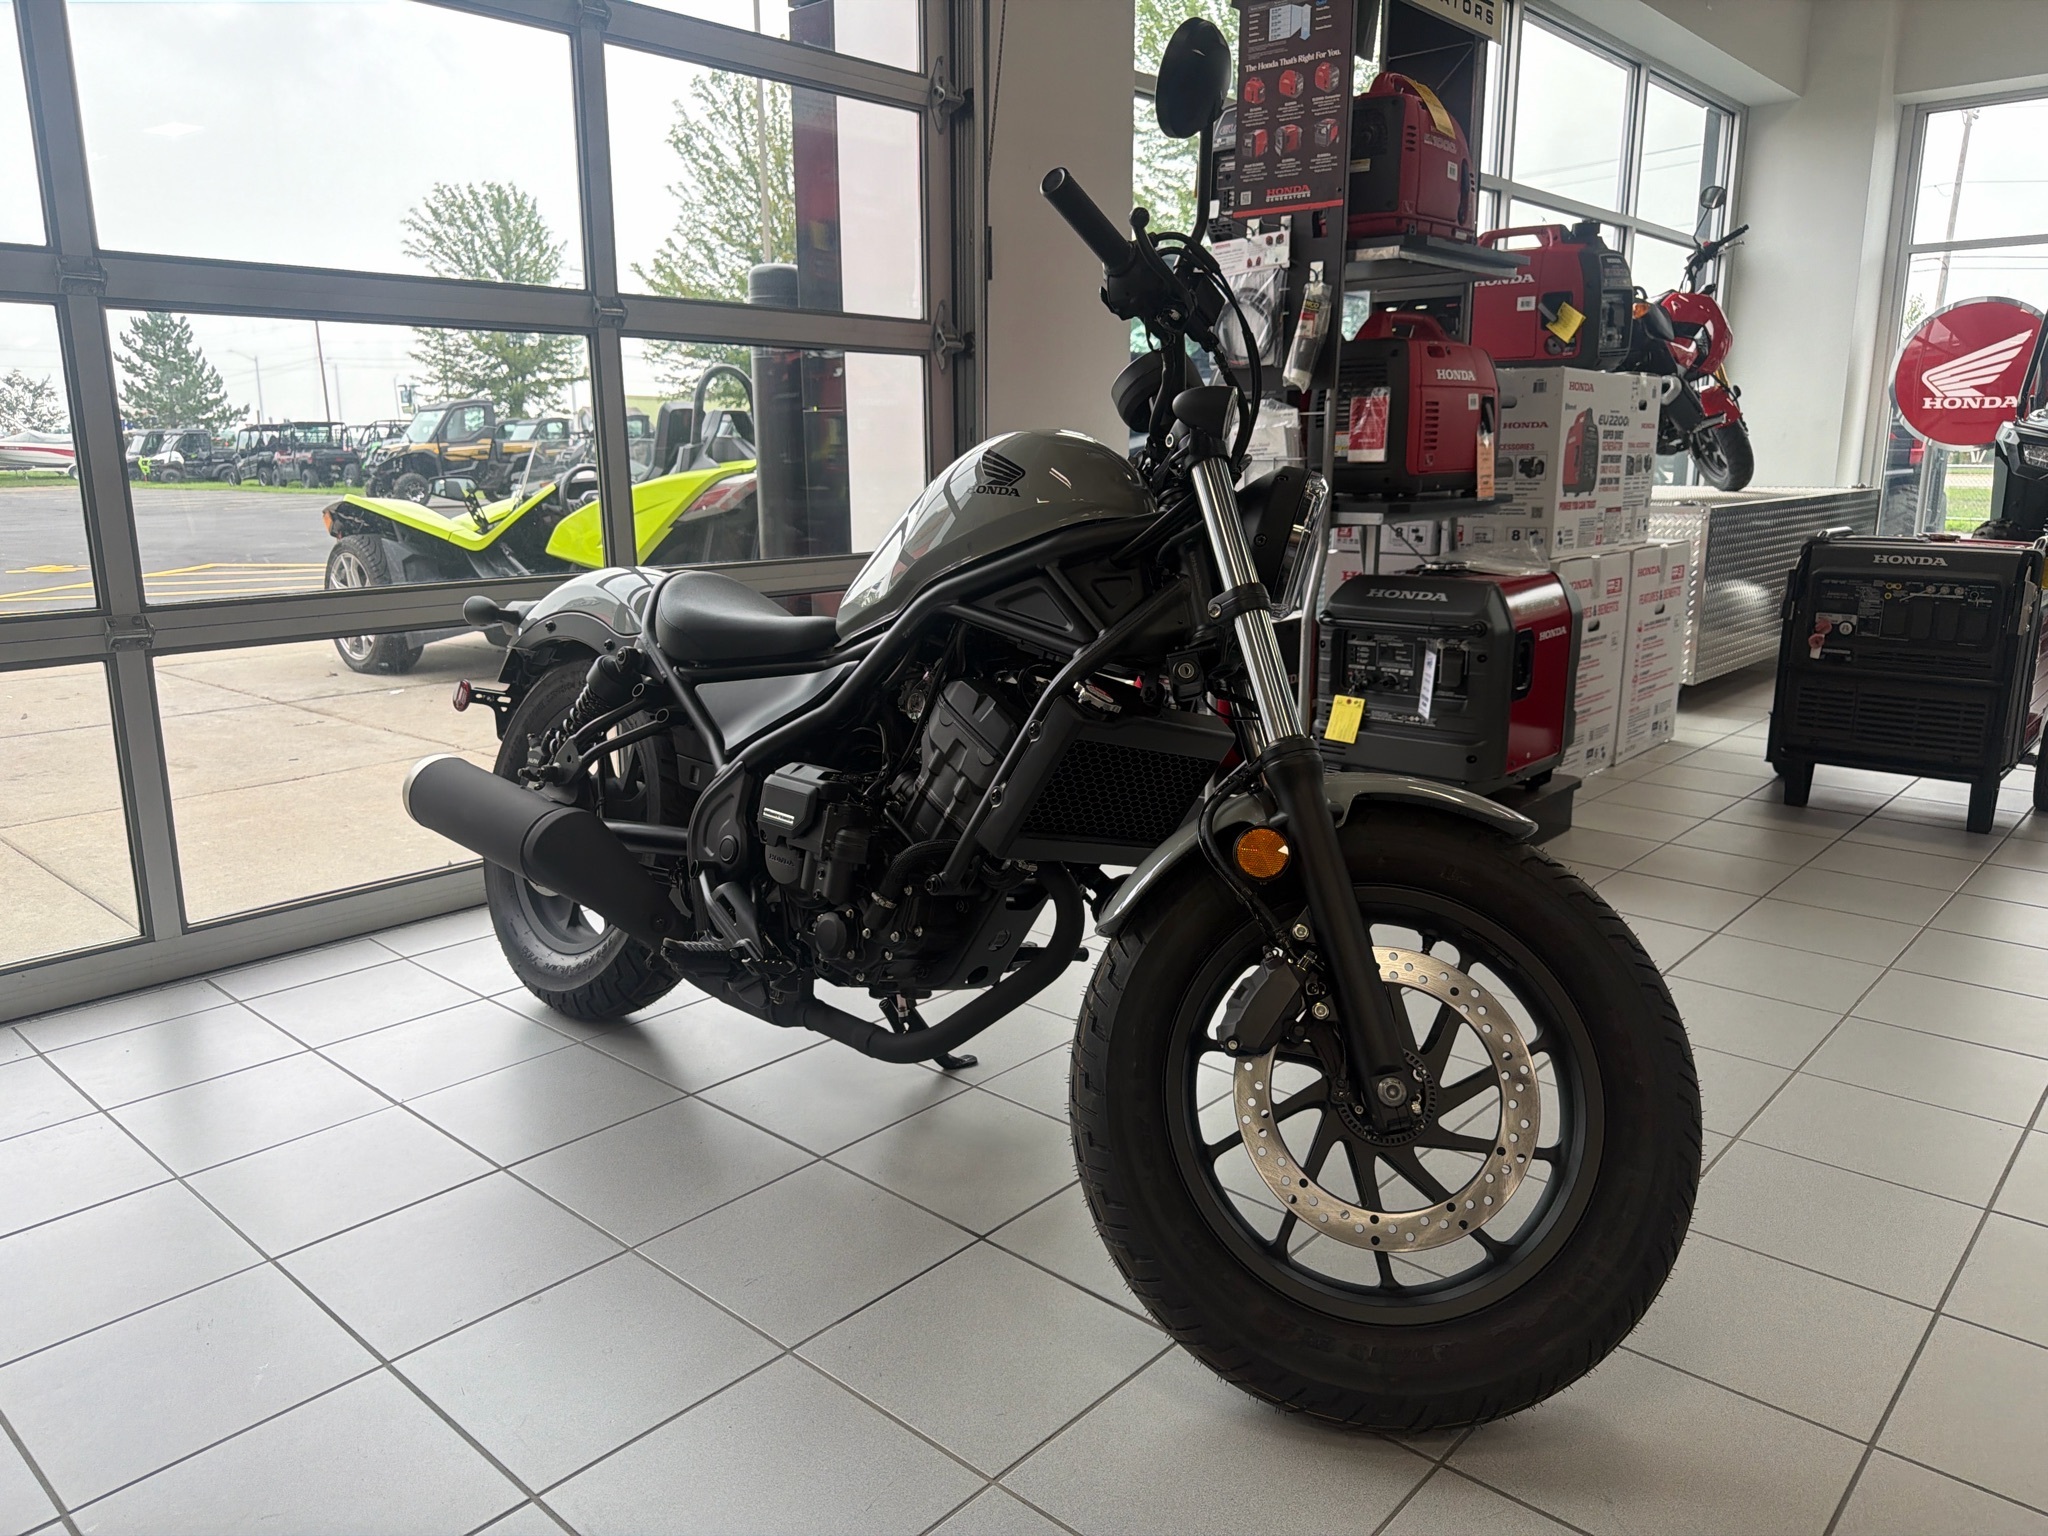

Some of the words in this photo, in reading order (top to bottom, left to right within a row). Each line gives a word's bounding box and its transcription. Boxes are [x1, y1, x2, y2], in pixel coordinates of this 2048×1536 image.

[1245, 64, 1257, 72] The
[1258, 60, 1278, 71] Honda
[1279, 56, 1297, 66] That's
[1298, 53, 1314, 64] Right
[1315, 51, 1327, 60] For
[1328, 48, 1341, 58] You.
[1266, 184, 1310, 196] HONDA
[1266, 191, 1311, 202] GENERATORS
[1436, 369, 1476, 381] HONDA
[1569, 381, 1594, 393] HONDA
[1922, 396, 2018, 409] HONDA
[1503, 421, 1549, 429] HONDA
[968, 485, 1021, 497] ONDA
[1511, 530, 1520, 541] 8
[1873, 554, 1948, 566] HONDA
[1637, 565, 1660, 577] HONDA
[1570, 579, 1593, 590] ONDA
[1366, 588, 1448, 602] HONDA
[1539, 626, 1567, 641] HONDA
